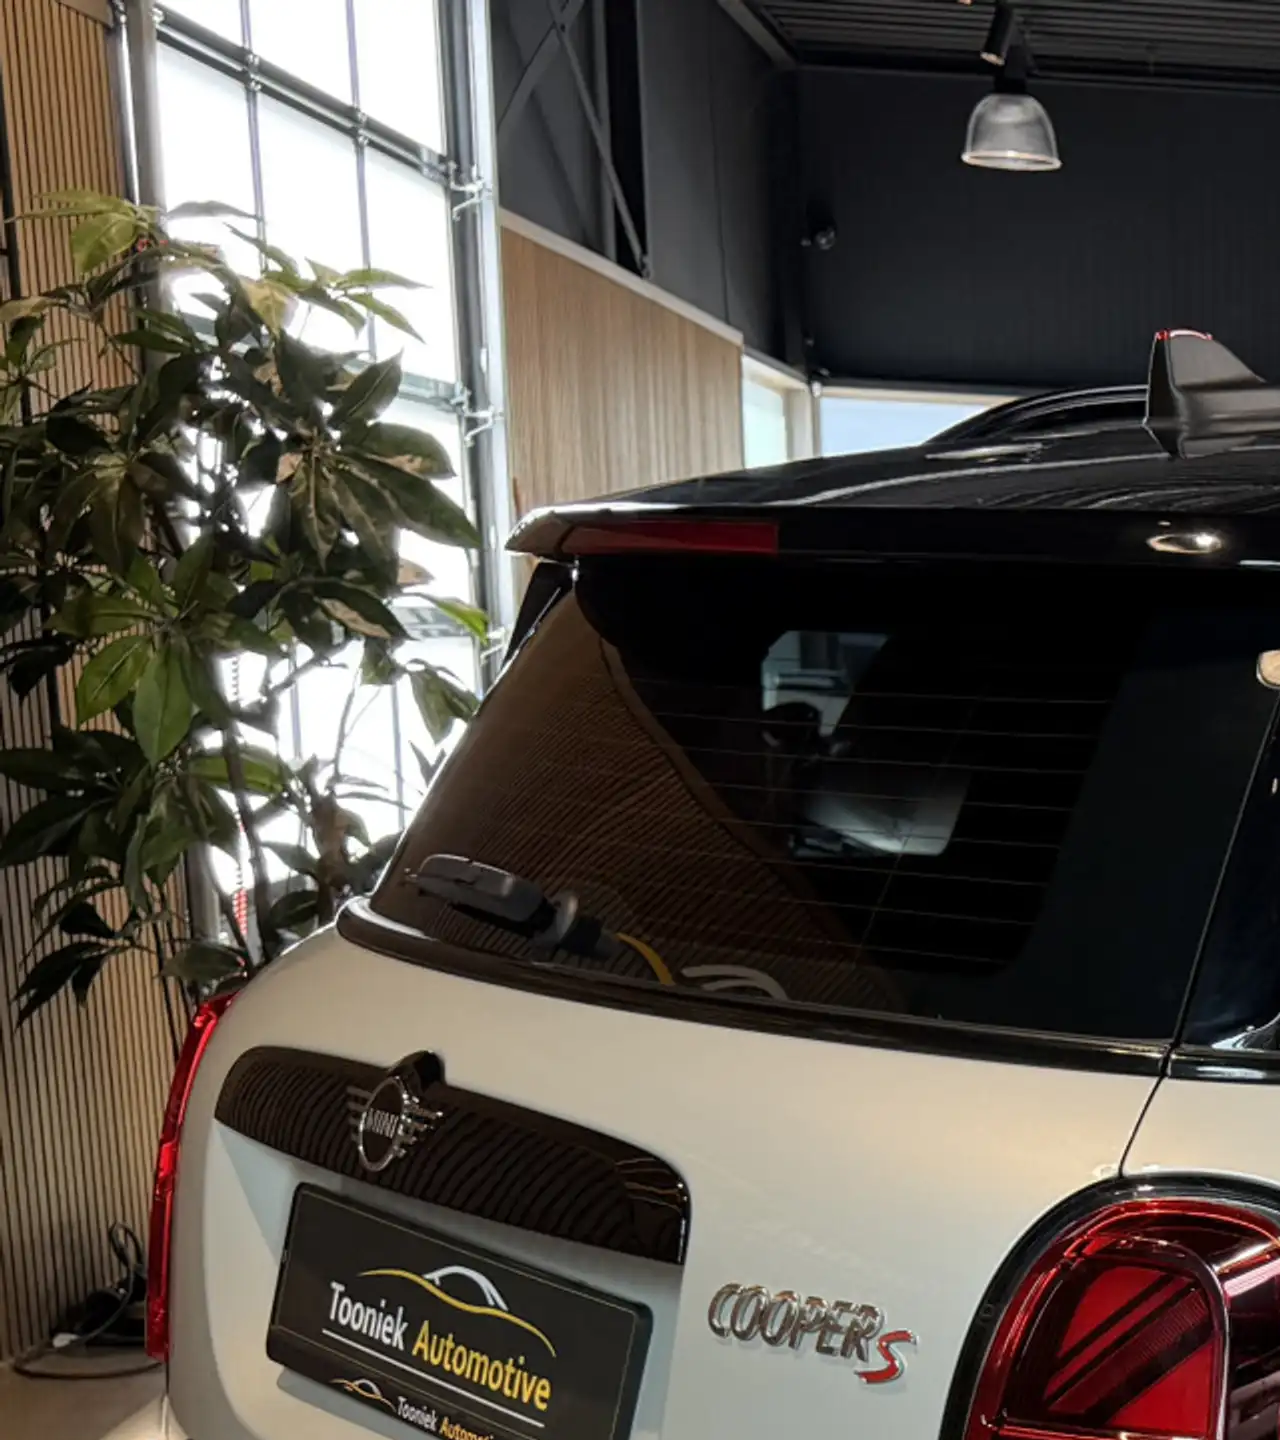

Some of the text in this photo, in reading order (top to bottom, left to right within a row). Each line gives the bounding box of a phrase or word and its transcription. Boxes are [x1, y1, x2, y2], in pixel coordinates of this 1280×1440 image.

[365, 1107, 399, 1139] MINI
[330, 1280, 551, 1412] Tooniek Automotive
[708, 1282, 920, 1384] COOPER S
[396, 1396, 437, 1431] Tooniek
